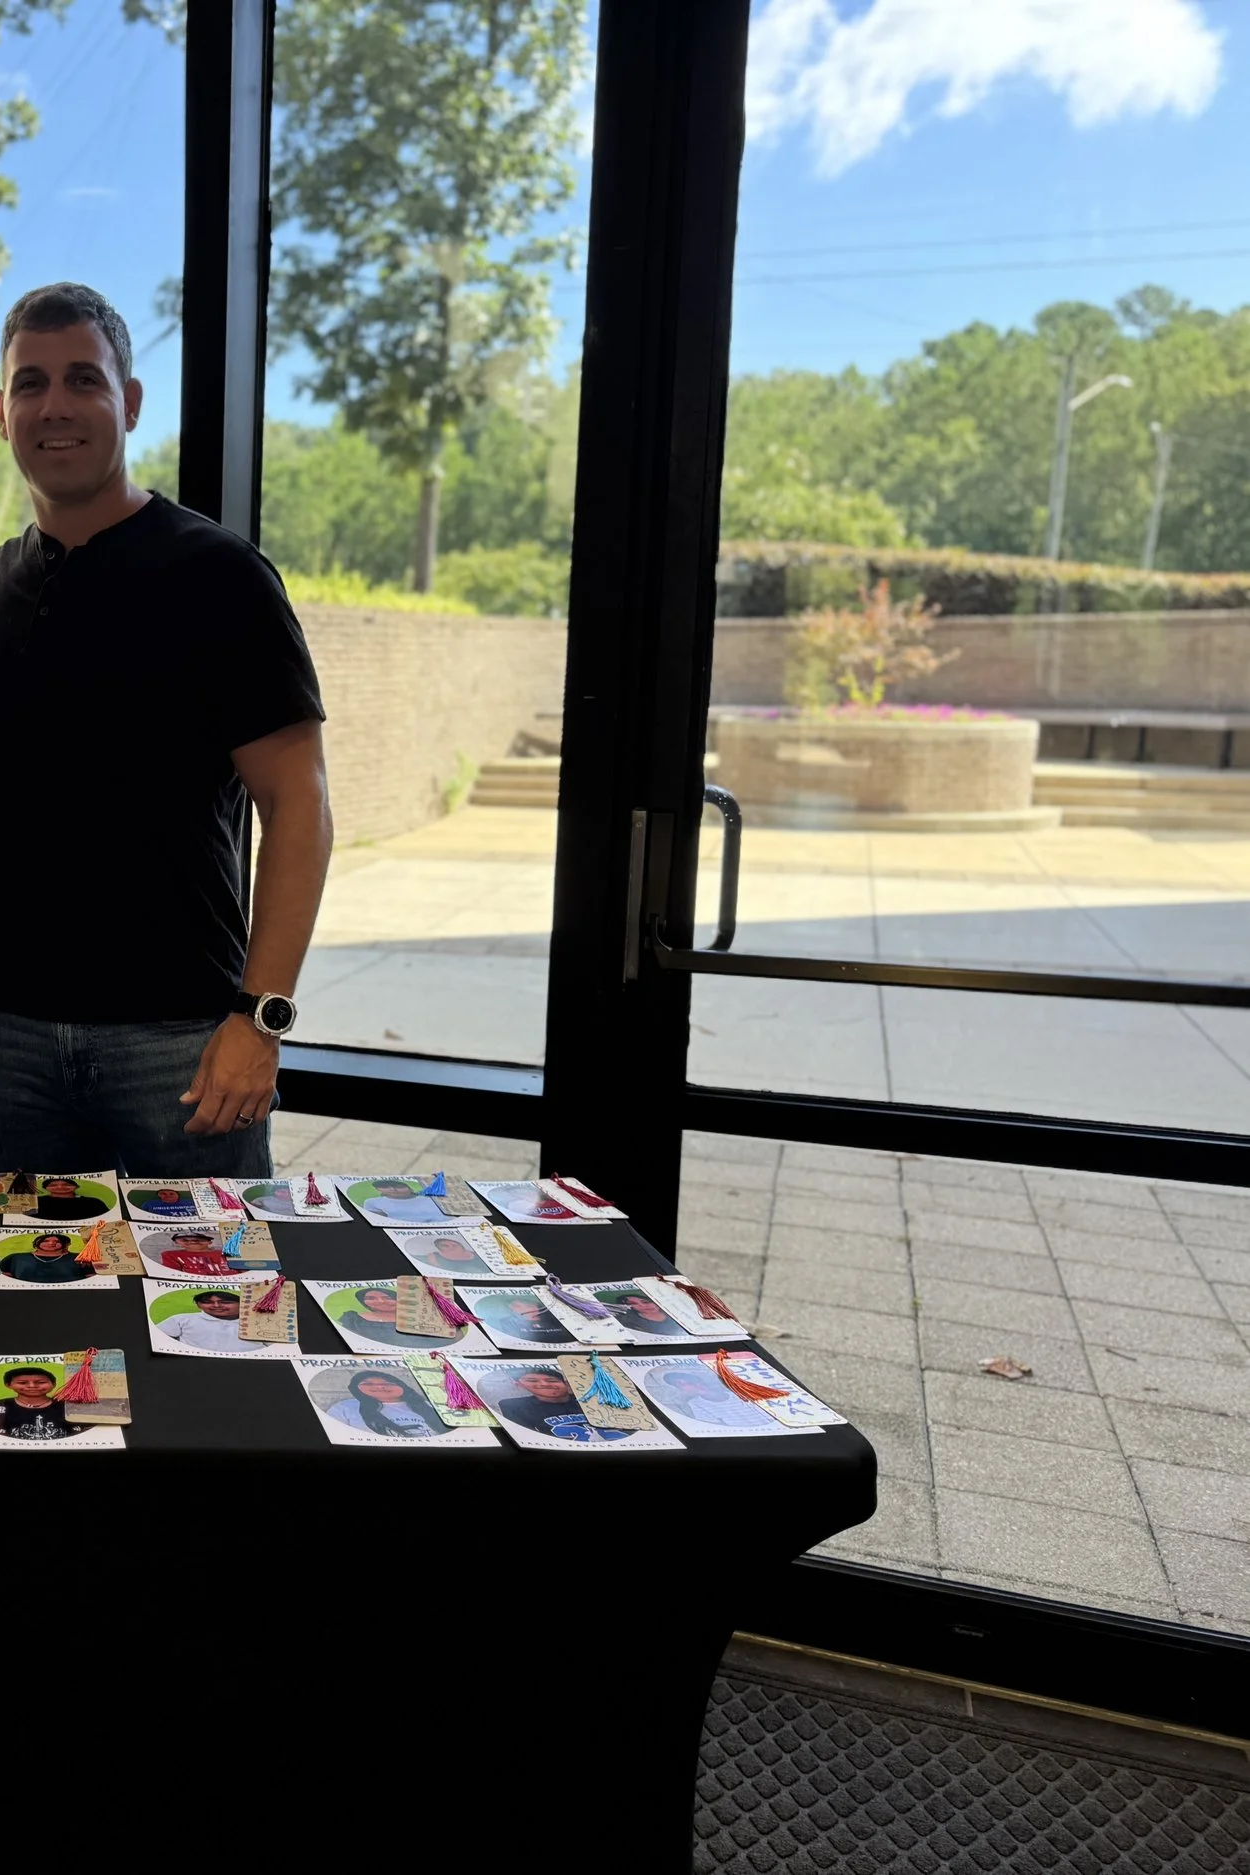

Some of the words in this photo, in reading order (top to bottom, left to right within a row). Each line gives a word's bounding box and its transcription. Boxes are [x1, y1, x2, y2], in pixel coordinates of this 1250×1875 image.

[157, 1281, 202, 1289] PRAYER
[317, 1281, 364, 1289] PRAYER
[300, 1359, 357, 1368] PRAYER
[363, 1359, 402, 1368] PART
[458, 1362, 513, 1372] PRAYER
[624, 1358, 671, 1368] PRAYER
